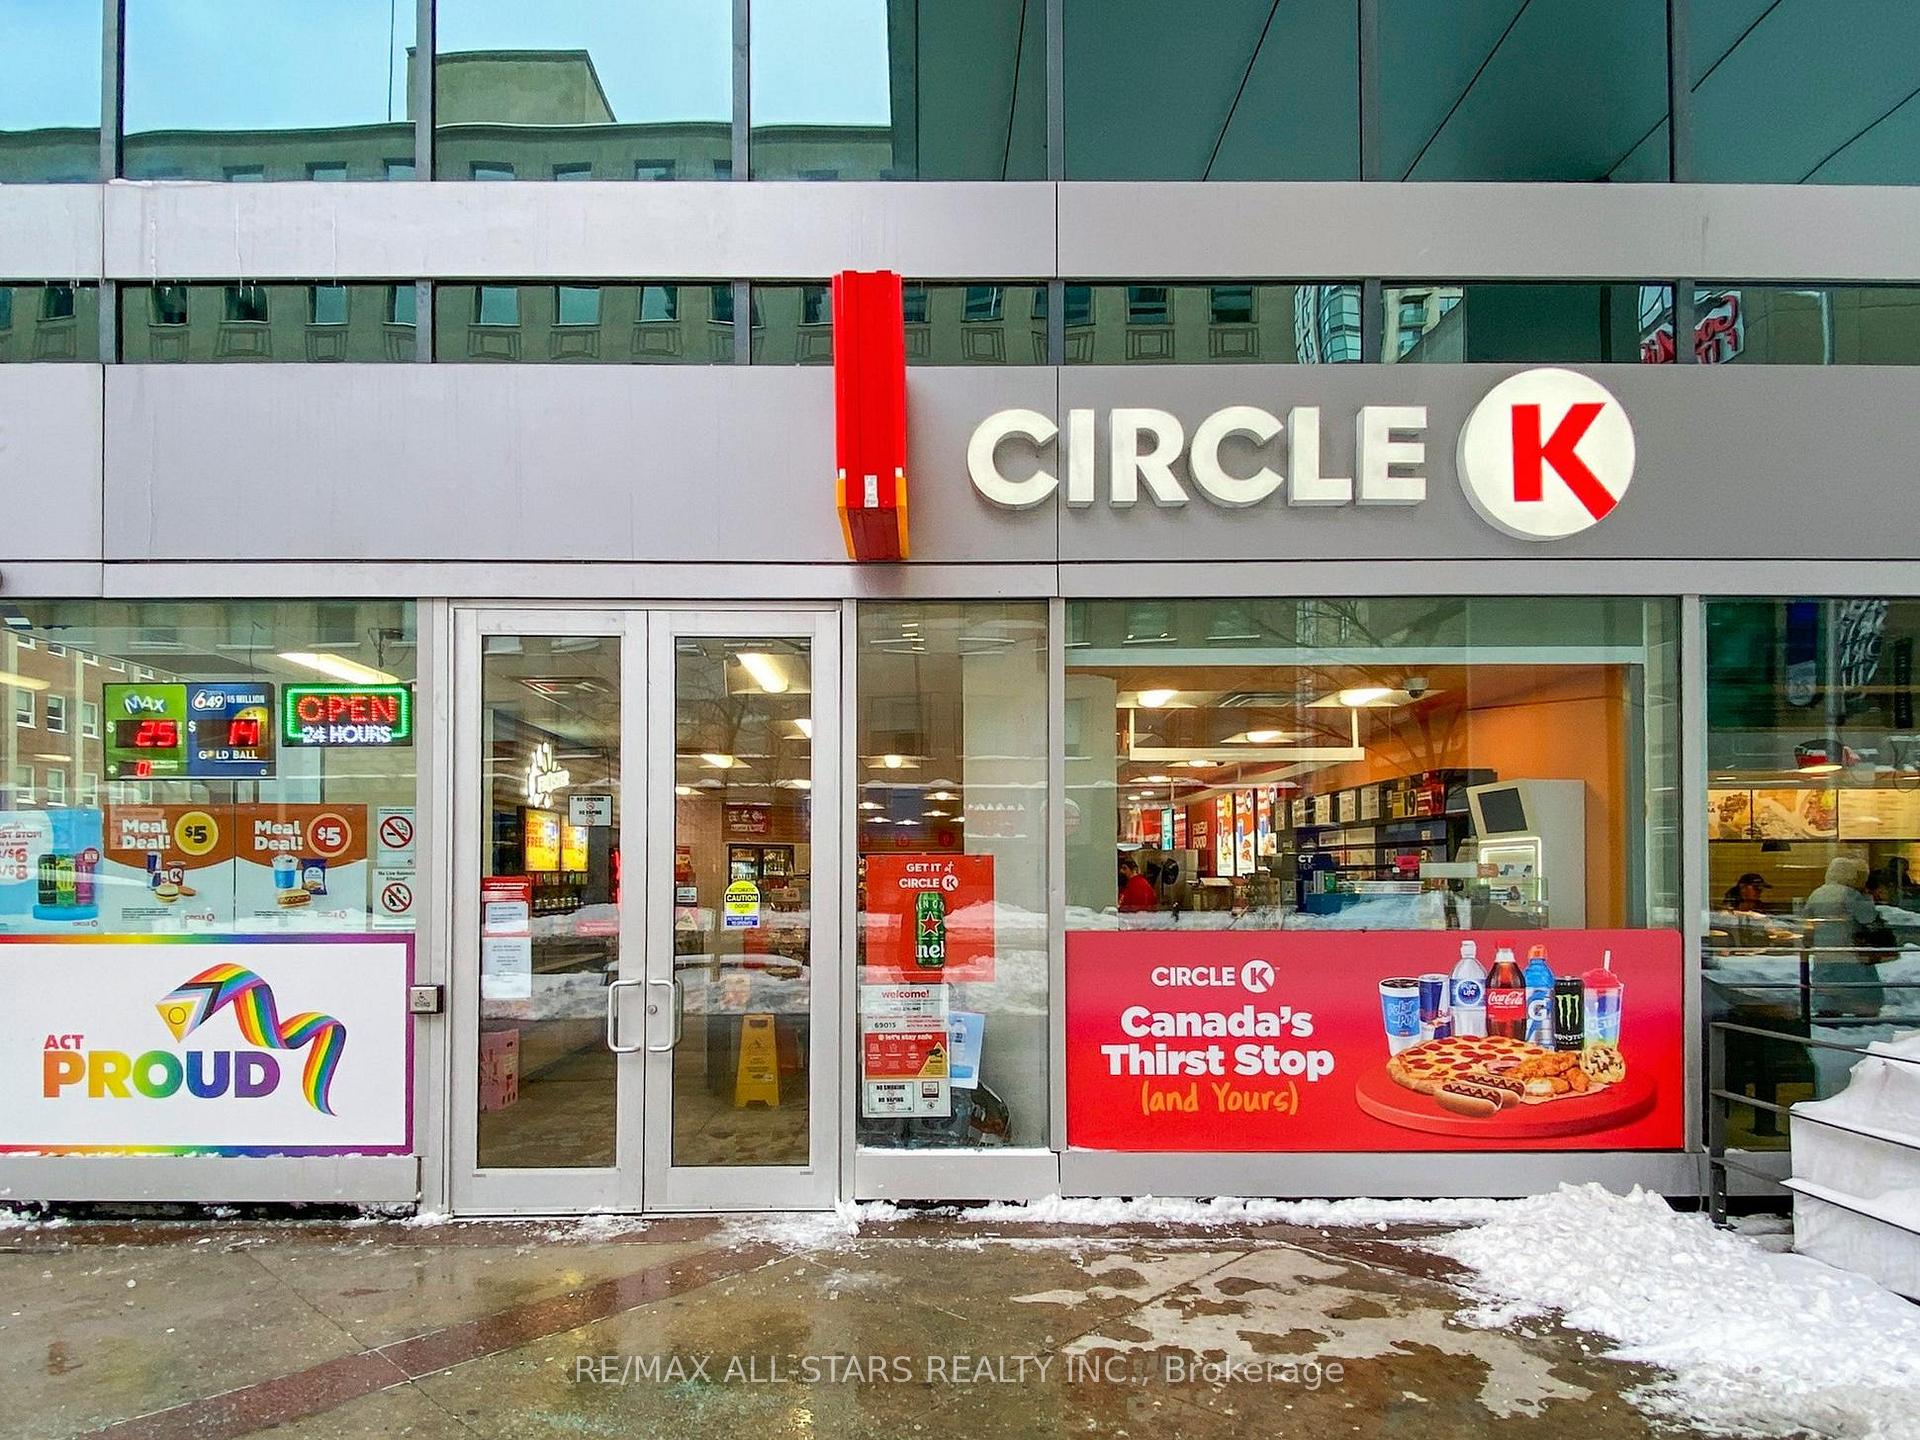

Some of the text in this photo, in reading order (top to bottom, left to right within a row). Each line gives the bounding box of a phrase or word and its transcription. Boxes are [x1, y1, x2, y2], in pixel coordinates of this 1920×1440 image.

[966, 405, 1428, 508] CIRCLE
[124, 695, 166, 714] MAX
[298, 694, 397, 722] OPEN
[135, 721, 177, 747] 25
[302, 724, 392, 743] 24 HOURS
[232, 750, 259, 760] BALL
[122, 818, 168, 834] Meal
[185, 825, 208, 844] $5
[254, 820, 301, 835] Meal
[122, 835, 171, 850] Deal!
[254, 836, 304, 851] Deal!
[317, 826, 342, 846] $5
[906, 863, 929, 872] GET
[931, 863, 941, 872] IT
[899, 878, 940, 889] CIRCLE
[727, 894, 758, 902] CAUTION
[1151, 966, 1236, 987] CIRCLE
[881, 990, 930, 999] welcome!
[1528, 999, 1548, 1020] G
[1120, 1004, 1315, 1038] Canada's
[44, 1034, 84, 1050] ACT
[1101, 1043, 1336, 1082] Thirst Stop
[43, 1050, 281, 1099] PROUD
[1141, 1081, 1299, 1116] (and Yours)
